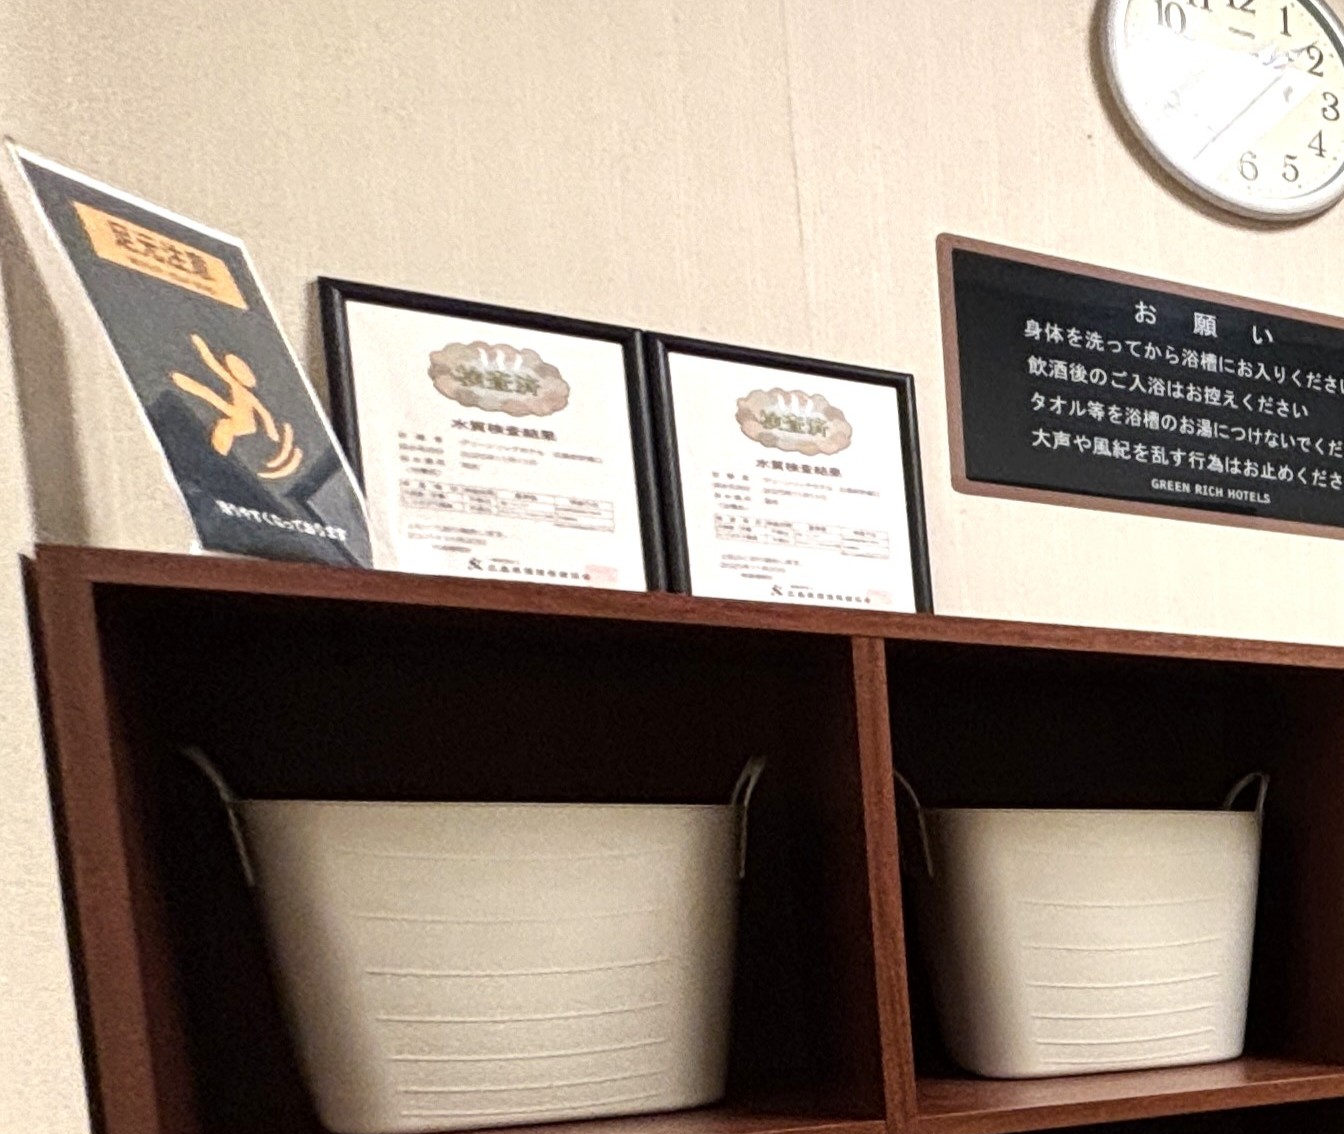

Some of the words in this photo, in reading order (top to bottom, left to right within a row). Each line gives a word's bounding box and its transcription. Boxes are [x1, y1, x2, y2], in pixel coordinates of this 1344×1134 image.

[1279, 6, 1293, 37] 1
[1306, 45, 1325, 78] 2
[1321, 91, 1341, 122] 3
[1307, 130, 1328, 159] 4
[1239, 150, 1260, 182] 6
[1281, 154, 1300, 183] 5
[107, 219, 216, 282] 足元注意
[1027, 355, 1310, 420] 飲酒後のご入浴はお控えください
[1151, 479, 1191, 494] GREEN
[1195, 484, 1224, 498] RICH
[1228, 489, 1271, 505] HOTELS
